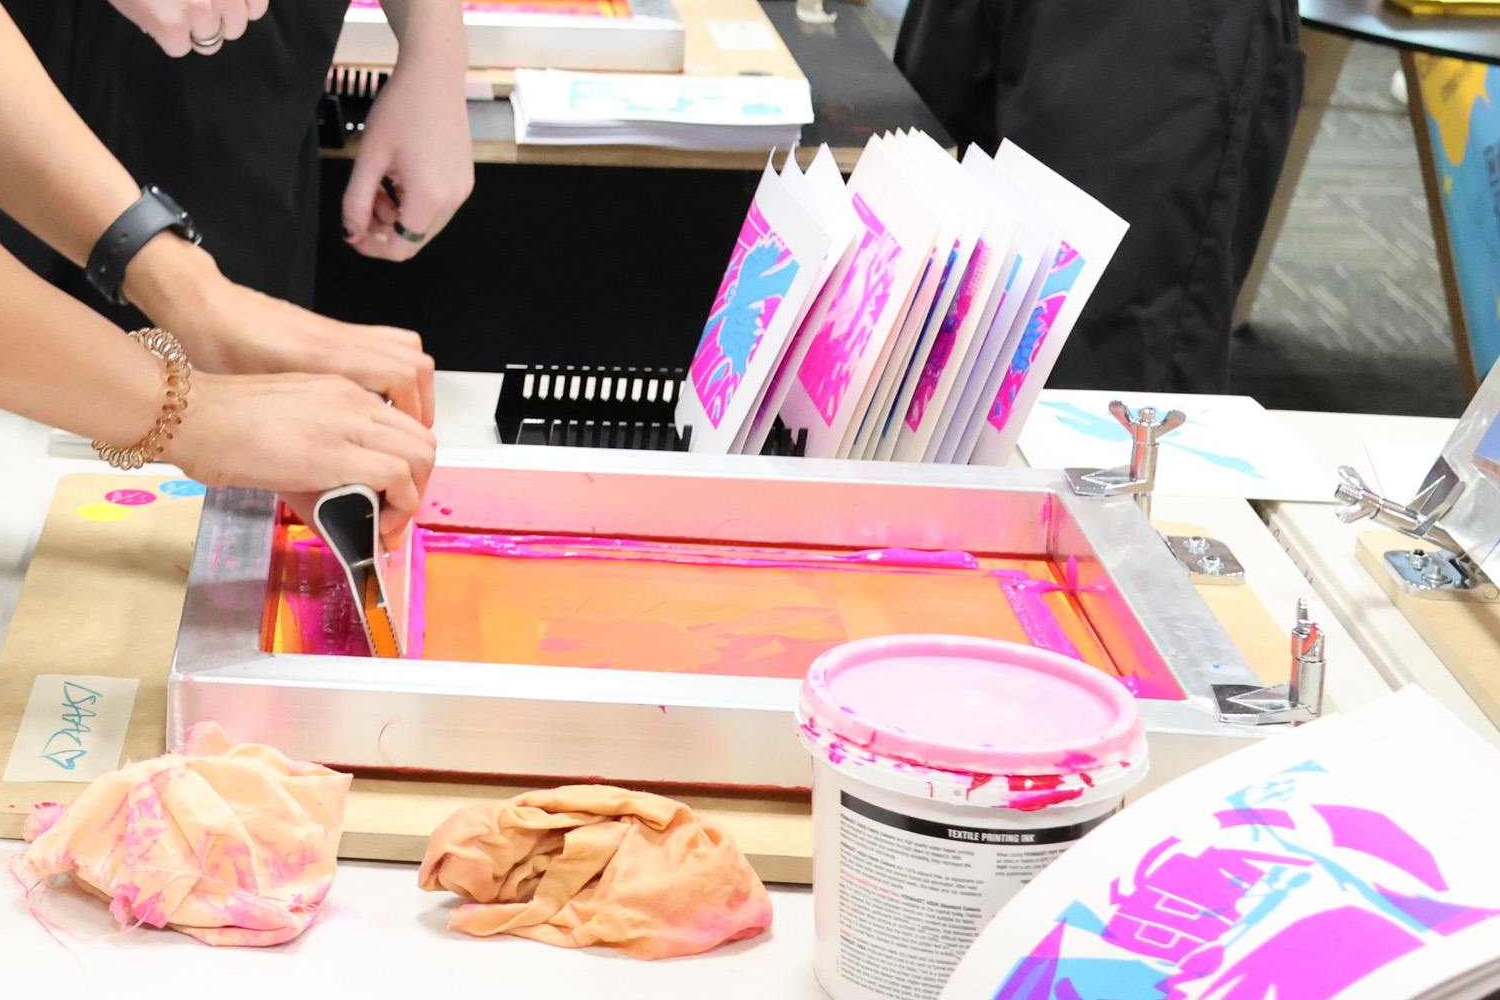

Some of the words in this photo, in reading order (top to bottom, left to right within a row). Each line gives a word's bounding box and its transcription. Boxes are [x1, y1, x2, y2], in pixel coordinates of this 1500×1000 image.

[947, 829, 979, 840] TEXTILE
[981, 832, 1020, 843] PRINTING
[1021, 833, 1035, 843] INK
